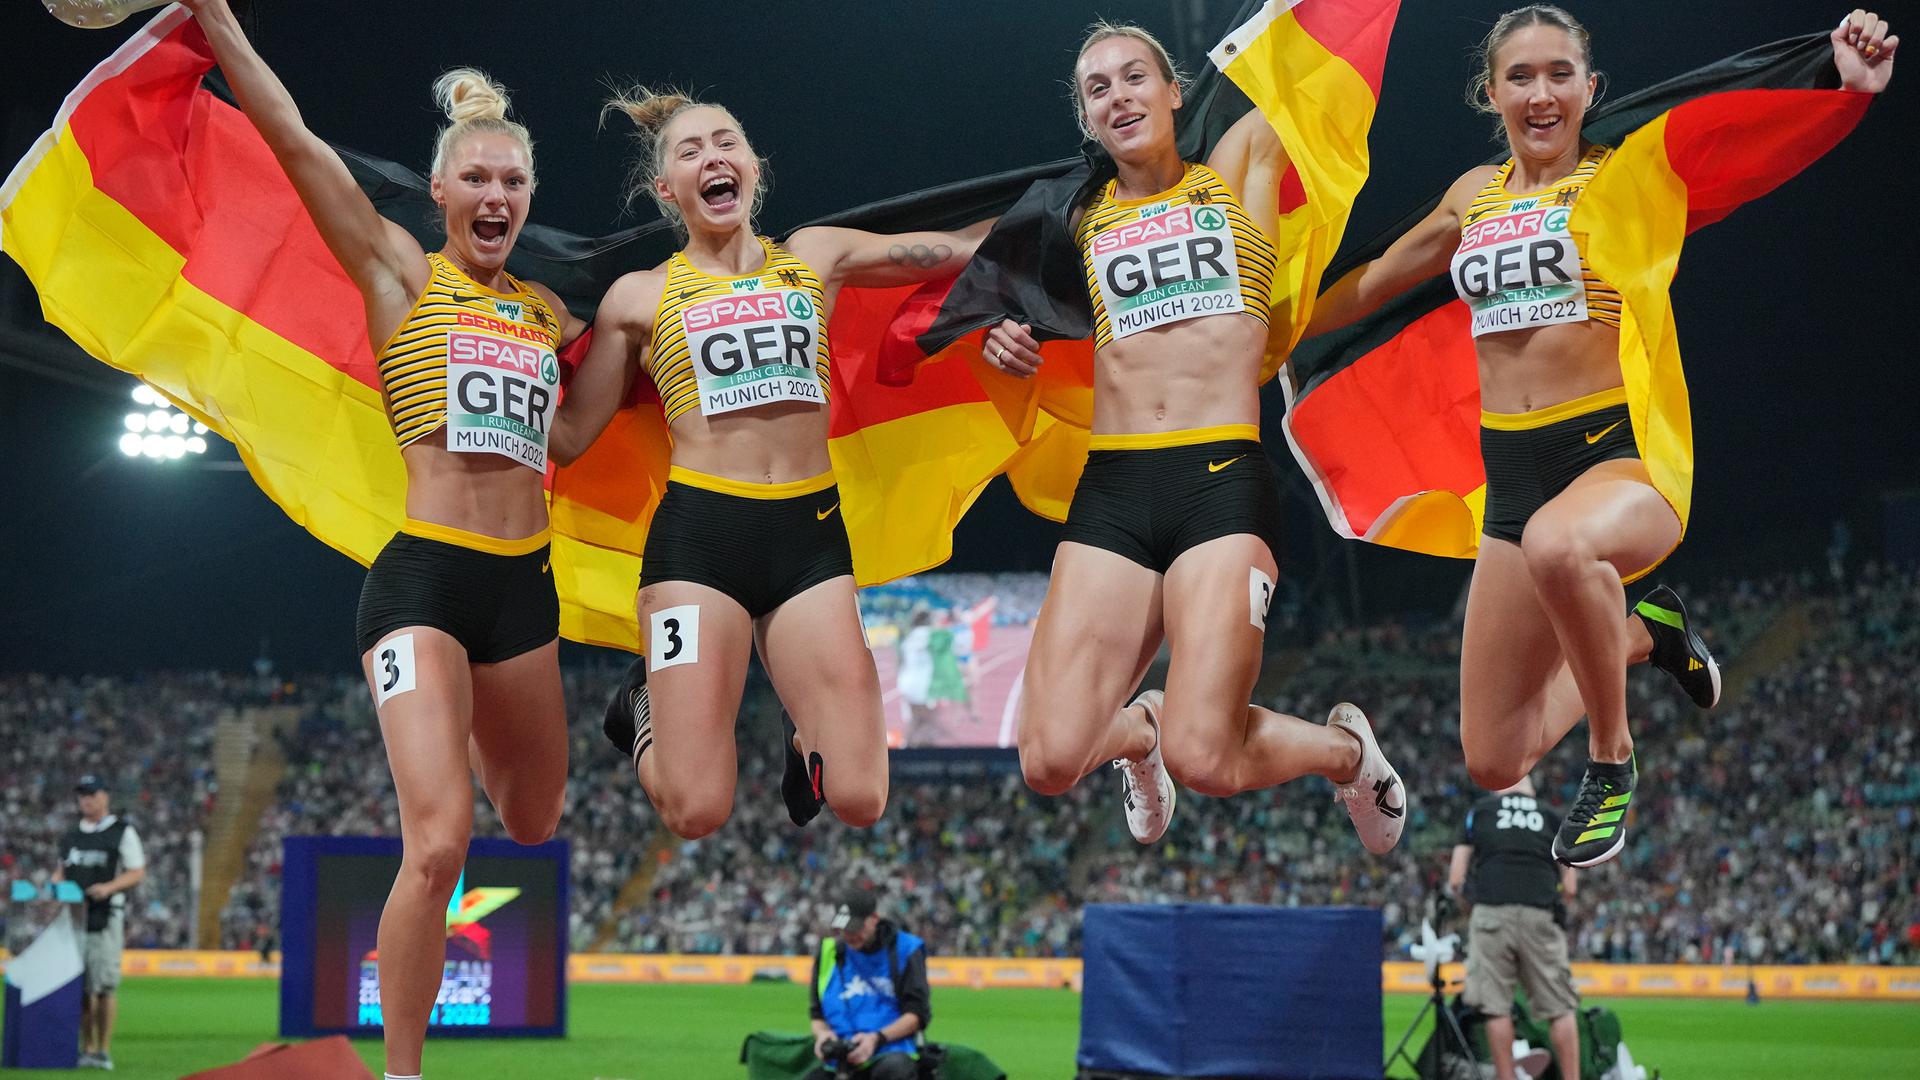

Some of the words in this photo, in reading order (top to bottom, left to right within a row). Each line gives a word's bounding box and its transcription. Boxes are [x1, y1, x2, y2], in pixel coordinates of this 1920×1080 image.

[1096, 210, 1190, 252] SPAR
[1462, 213, 1541, 251] SPAR
[1106, 236, 1230, 298] GER
[1459, 239, 1573, 298] GER
[687, 297, 783, 329] SPAR
[1118, 299, 1185, 332] MUNICH
[1191, 294, 1235, 312] 2022
[1142, 289, 1165, 303] RUN
[1475, 307, 1521, 331] MUNICH
[1528, 300, 1577, 321] 2022
[453, 338, 537, 374] SPAR
[701, 324, 811, 377] GER
[737, 370, 762, 383] RUN
[457, 371, 550, 435] GER
[709, 381, 782, 410] MUNICH
[787, 381, 819, 398] 2022
[488, 416, 511, 430] RUN
[456, 431, 519, 455] MUNICH
[522, 443, 543, 467] 2022
[663, 618, 683, 661] 3
[380, 648, 400, 692] 3
[1496, 809, 1544, 832] 240
